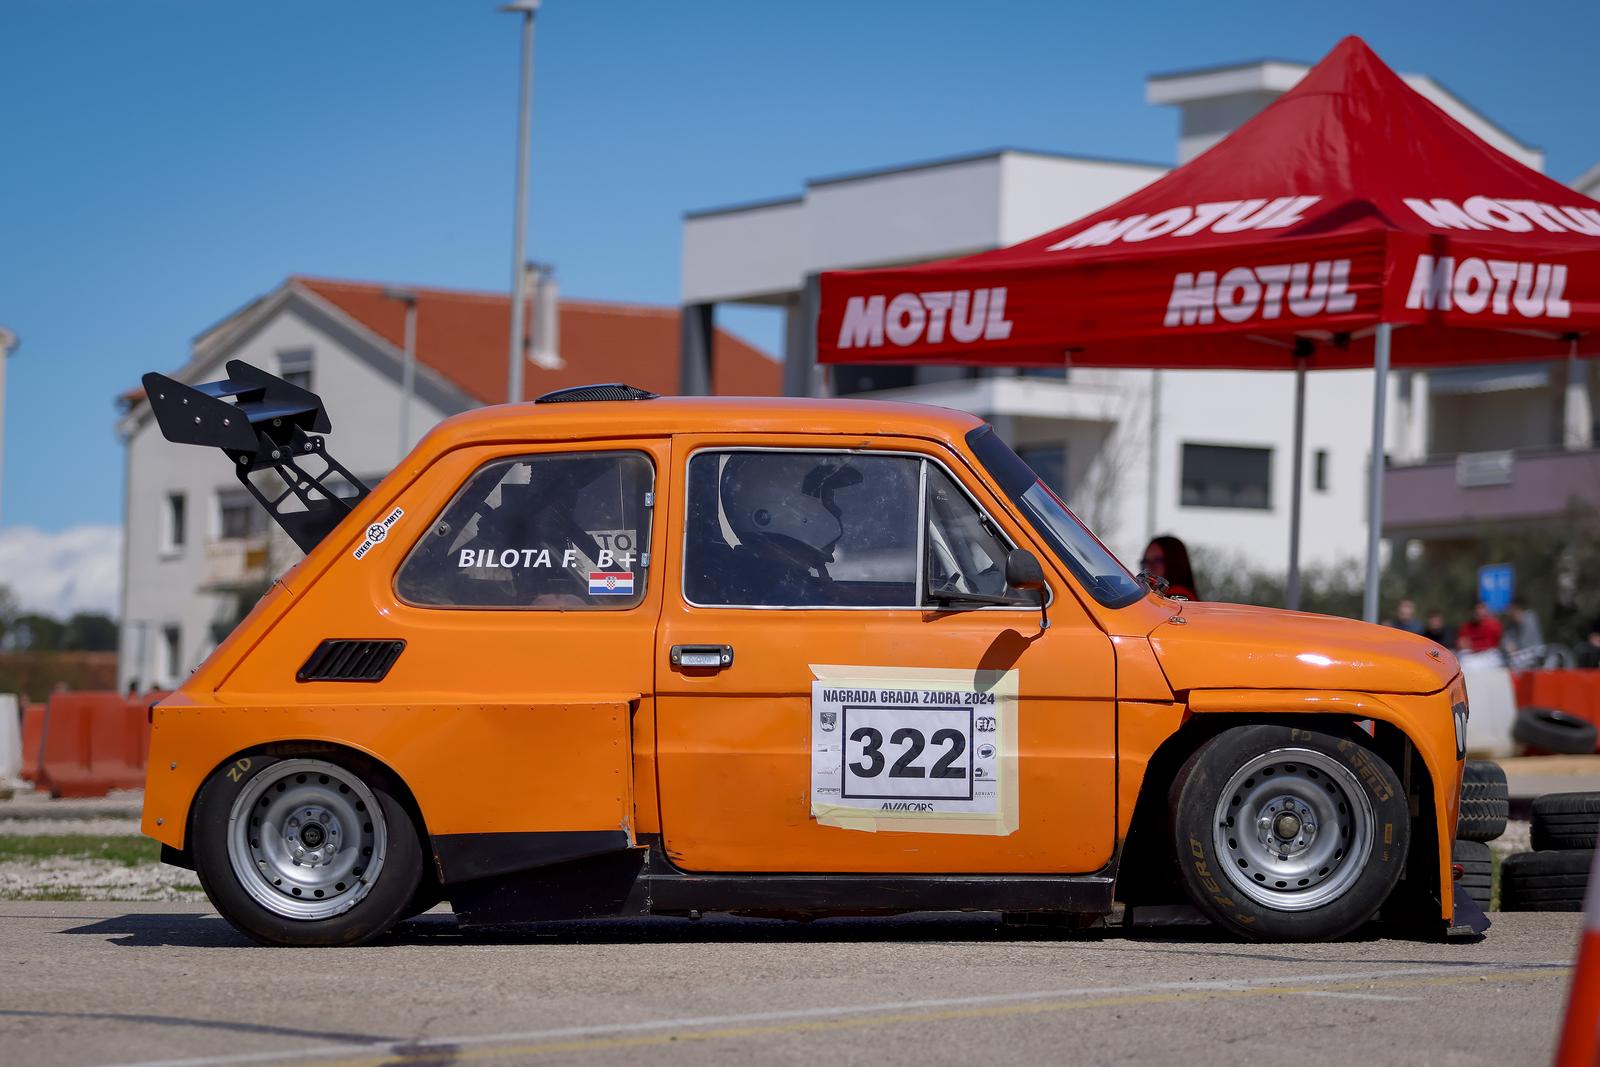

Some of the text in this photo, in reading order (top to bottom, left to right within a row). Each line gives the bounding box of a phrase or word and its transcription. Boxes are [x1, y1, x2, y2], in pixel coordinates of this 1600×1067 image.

[1045, 195, 1322, 251] MOTUL
[1163, 259, 1358, 327] MOTUL
[1405, 254, 1571, 318] MOTUL
[837, 287, 1013, 349] MOTUL
[354, 508, 403, 559] DIXER PARTS
[458, 549, 551, 568] BILOTA
[562, 549, 577, 568] F.
[823, 689, 995, 705] NAGRADA GRADA ZADRA 2024
[226, 757, 252, 783] ZD
[848, 726, 967, 779] 322
